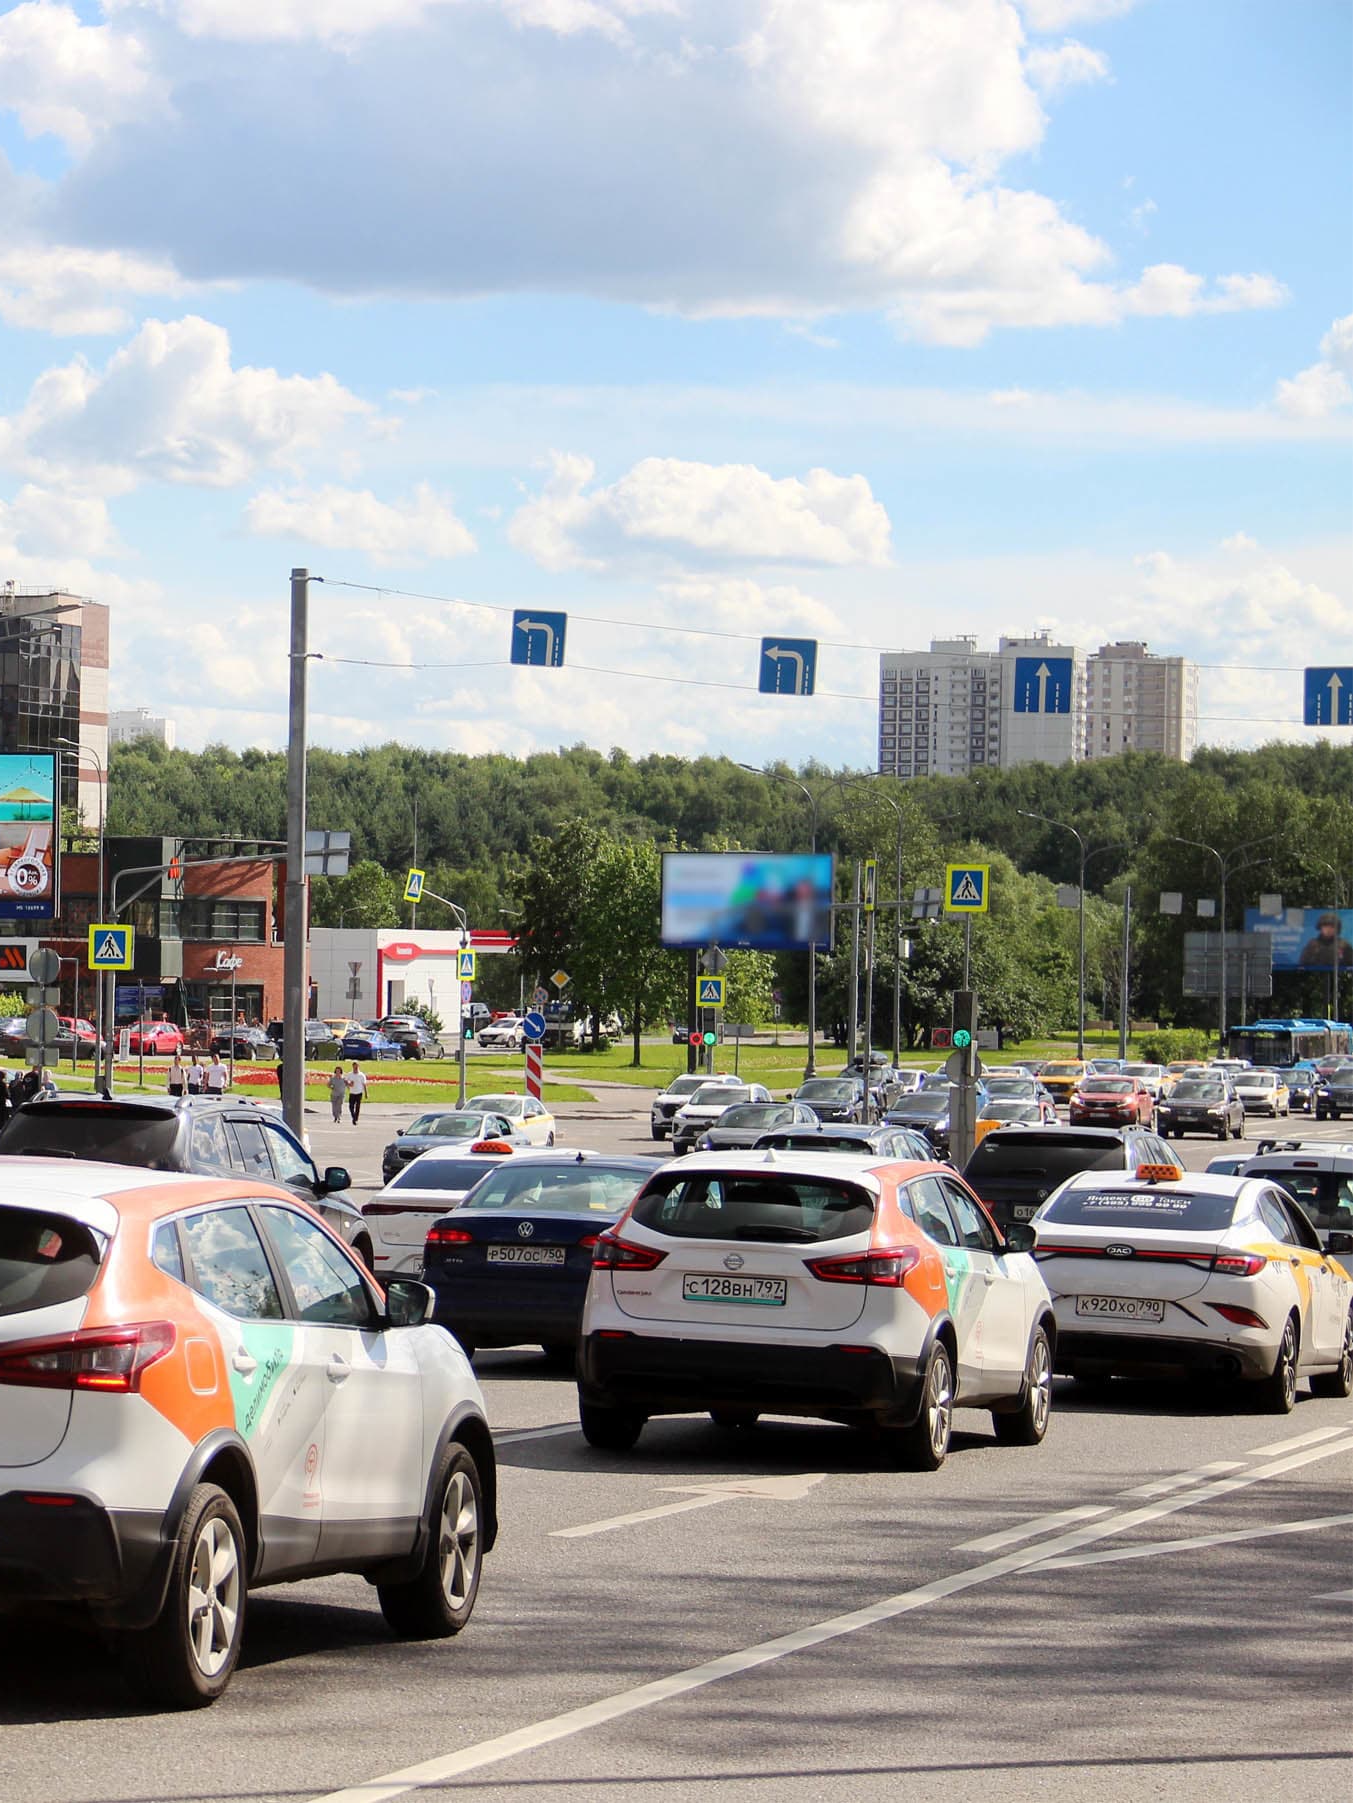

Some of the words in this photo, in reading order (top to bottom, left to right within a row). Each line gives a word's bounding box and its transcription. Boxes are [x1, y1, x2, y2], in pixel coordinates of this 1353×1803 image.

[1159, 1196, 1192, 1205] Такси
[756, 1280, 781, 1294] 797
[1139, 1301, 1160, 1313] 790
